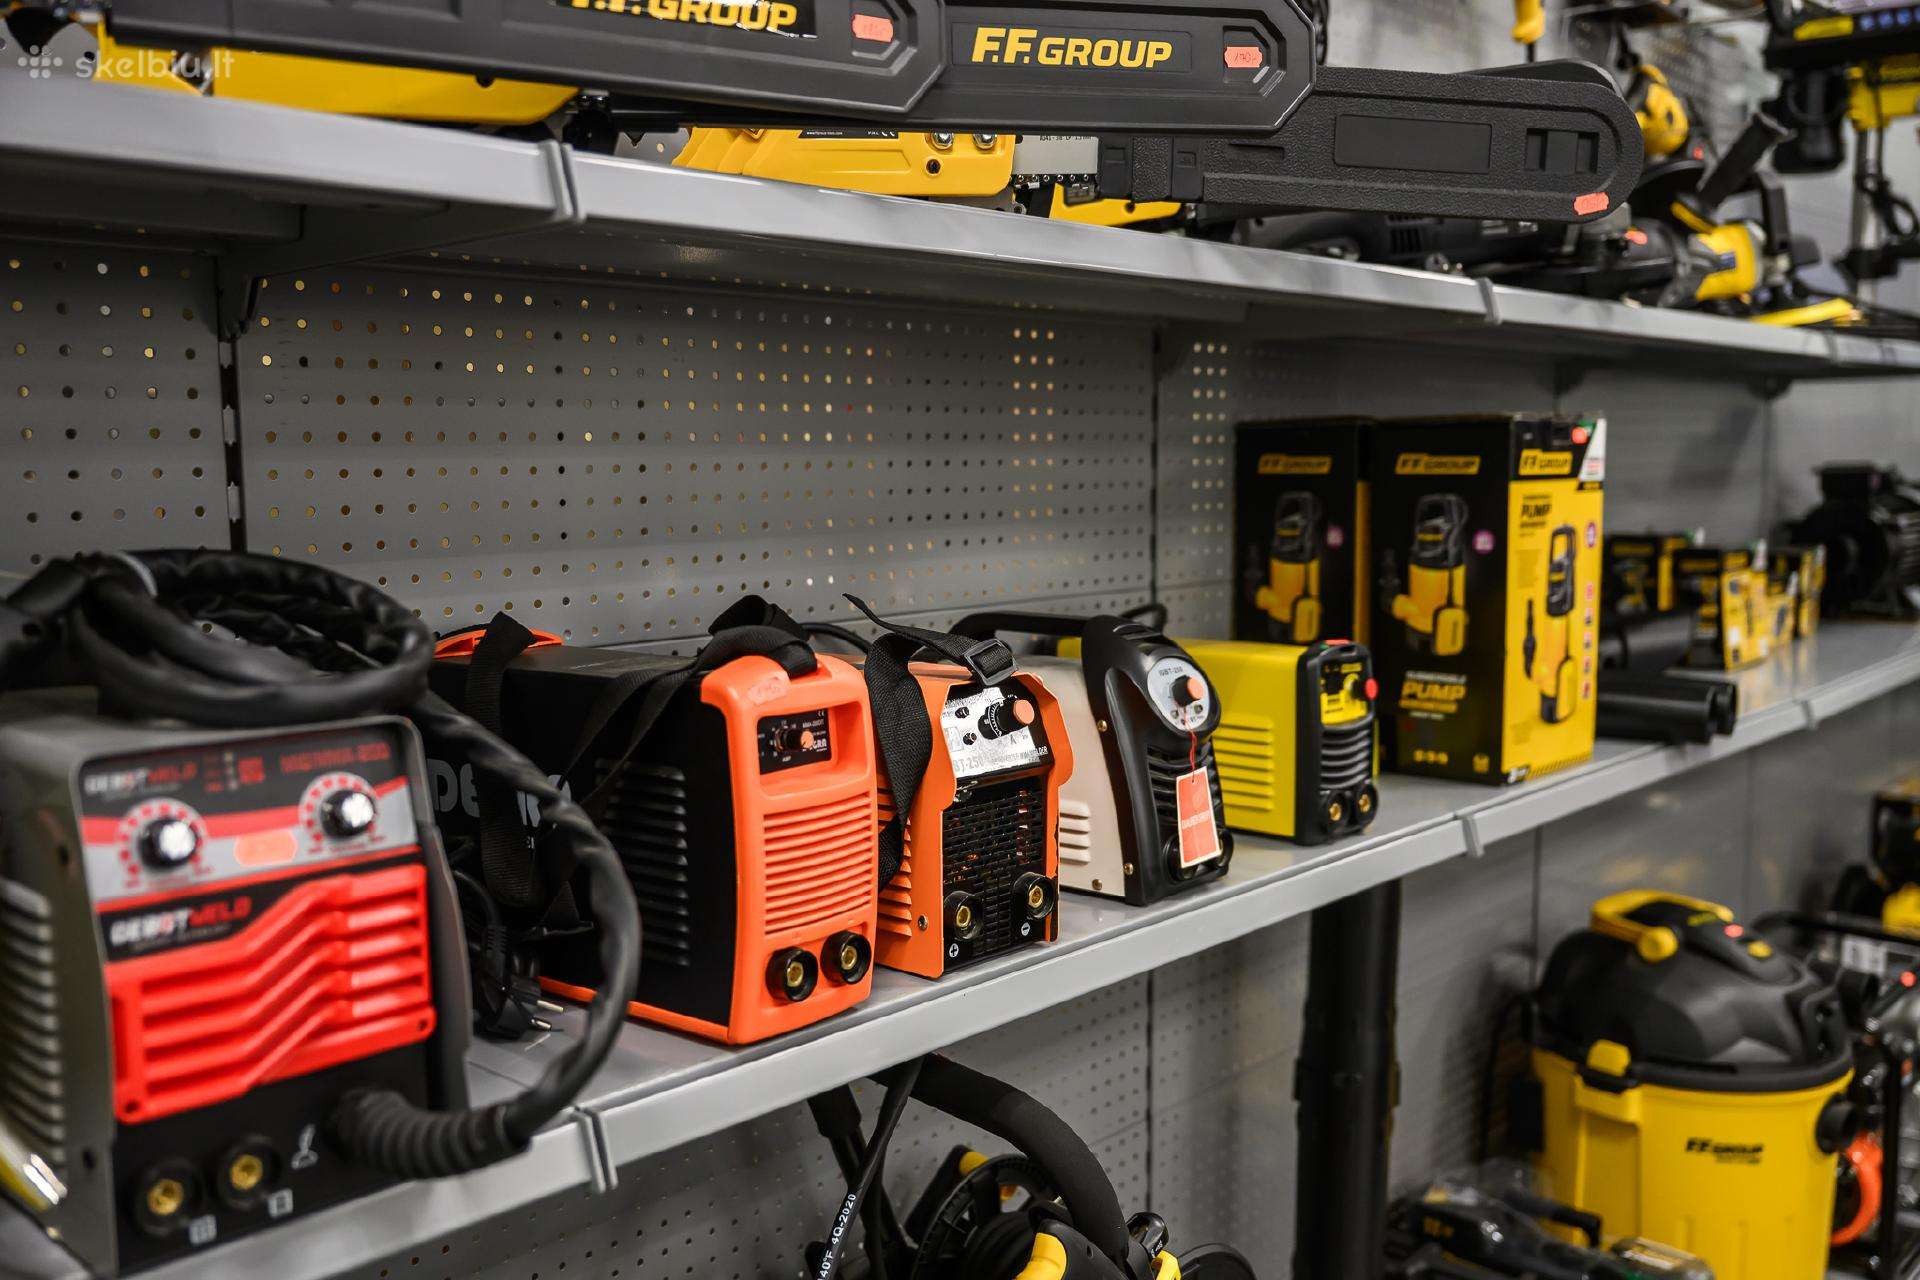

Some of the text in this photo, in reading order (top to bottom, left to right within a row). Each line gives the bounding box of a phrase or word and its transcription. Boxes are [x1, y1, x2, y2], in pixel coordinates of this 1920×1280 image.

[971, 26, 1173, 68] F.F. GROUP
[1401, 681, 1466, 701] PUMP
[831, 1193, 857, 1245] 4Q-2020
